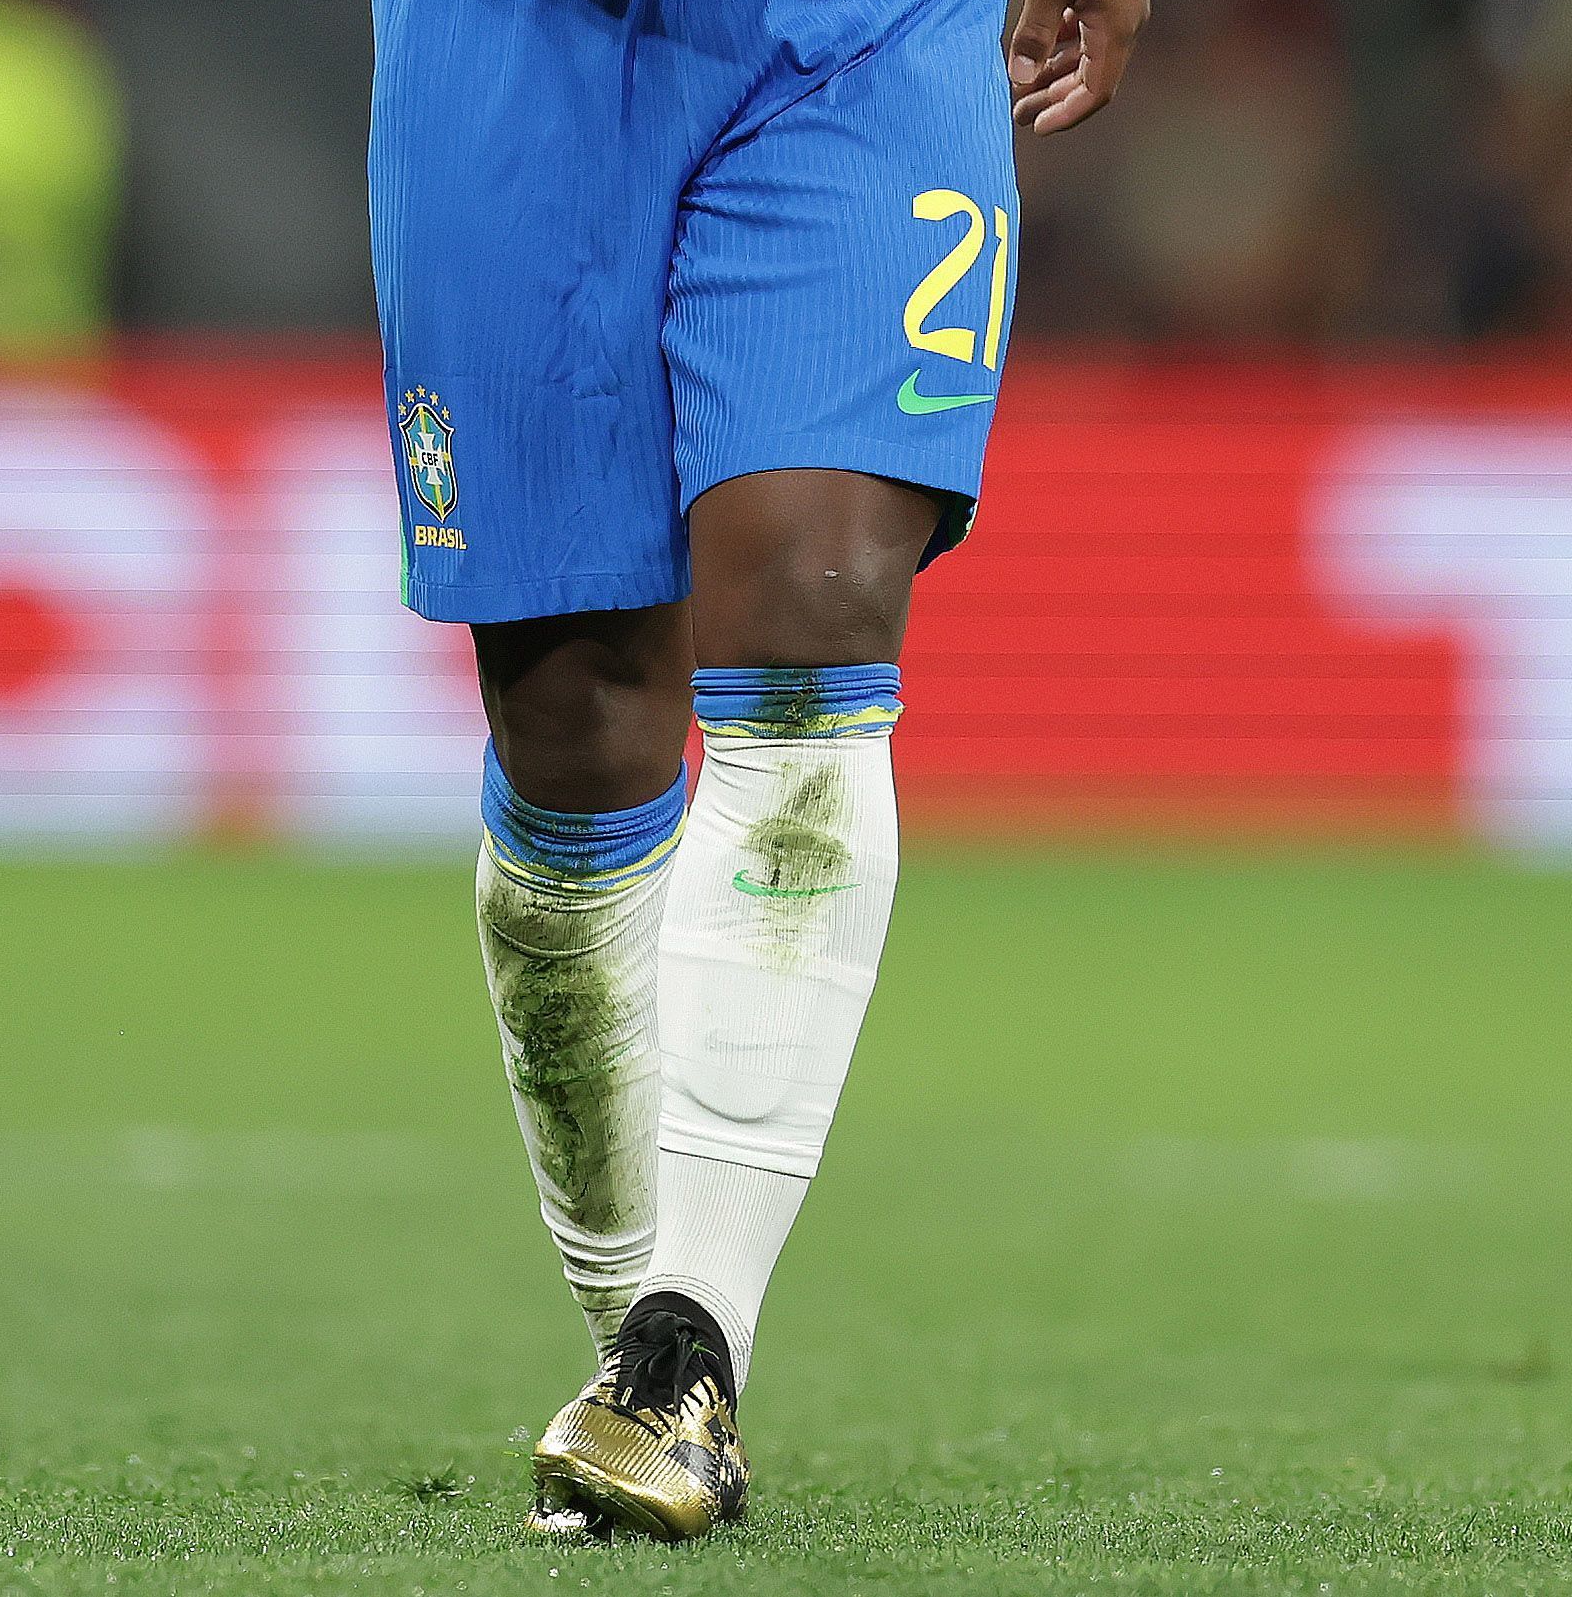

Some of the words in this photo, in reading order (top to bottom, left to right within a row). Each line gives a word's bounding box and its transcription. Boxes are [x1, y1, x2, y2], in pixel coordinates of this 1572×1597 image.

[903, 188, 1008, 372] 21
[422, 452, 439, 466] CBF
[414, 525, 468, 550] BRASIL
